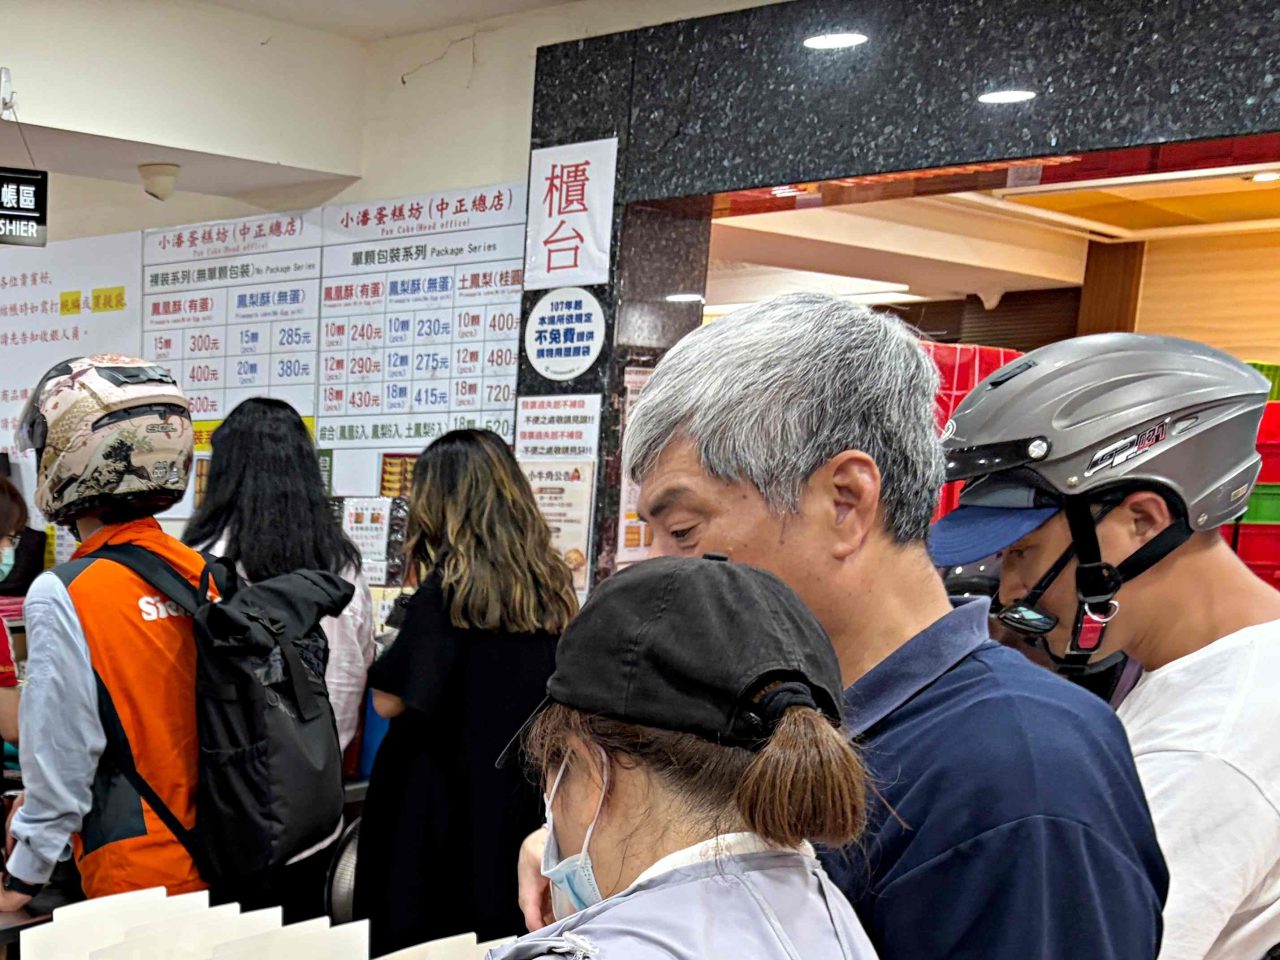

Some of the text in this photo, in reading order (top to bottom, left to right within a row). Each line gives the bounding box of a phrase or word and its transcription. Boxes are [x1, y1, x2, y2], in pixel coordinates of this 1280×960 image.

[340, 188, 513, 229] 小潘蛋糕坊(中正總店)
[543, 160, 591, 274] 櫃台
[430, 246, 464, 257] Package
[468, 242, 497, 253] Series
[279, 328, 311, 346] 285元
[351, 324, 382, 341] 240元
[417, 319, 450, 337] 230元
[189, 334, 219, 352] 300元
[278, 359, 310, 378] 380元
[350, 357, 381, 374] 290元
[416, 353, 449, 371] 275元
[189, 365, 219, 382] 400元
[349, 391, 380, 408] 430元
[415, 388, 448, 405] 415元
